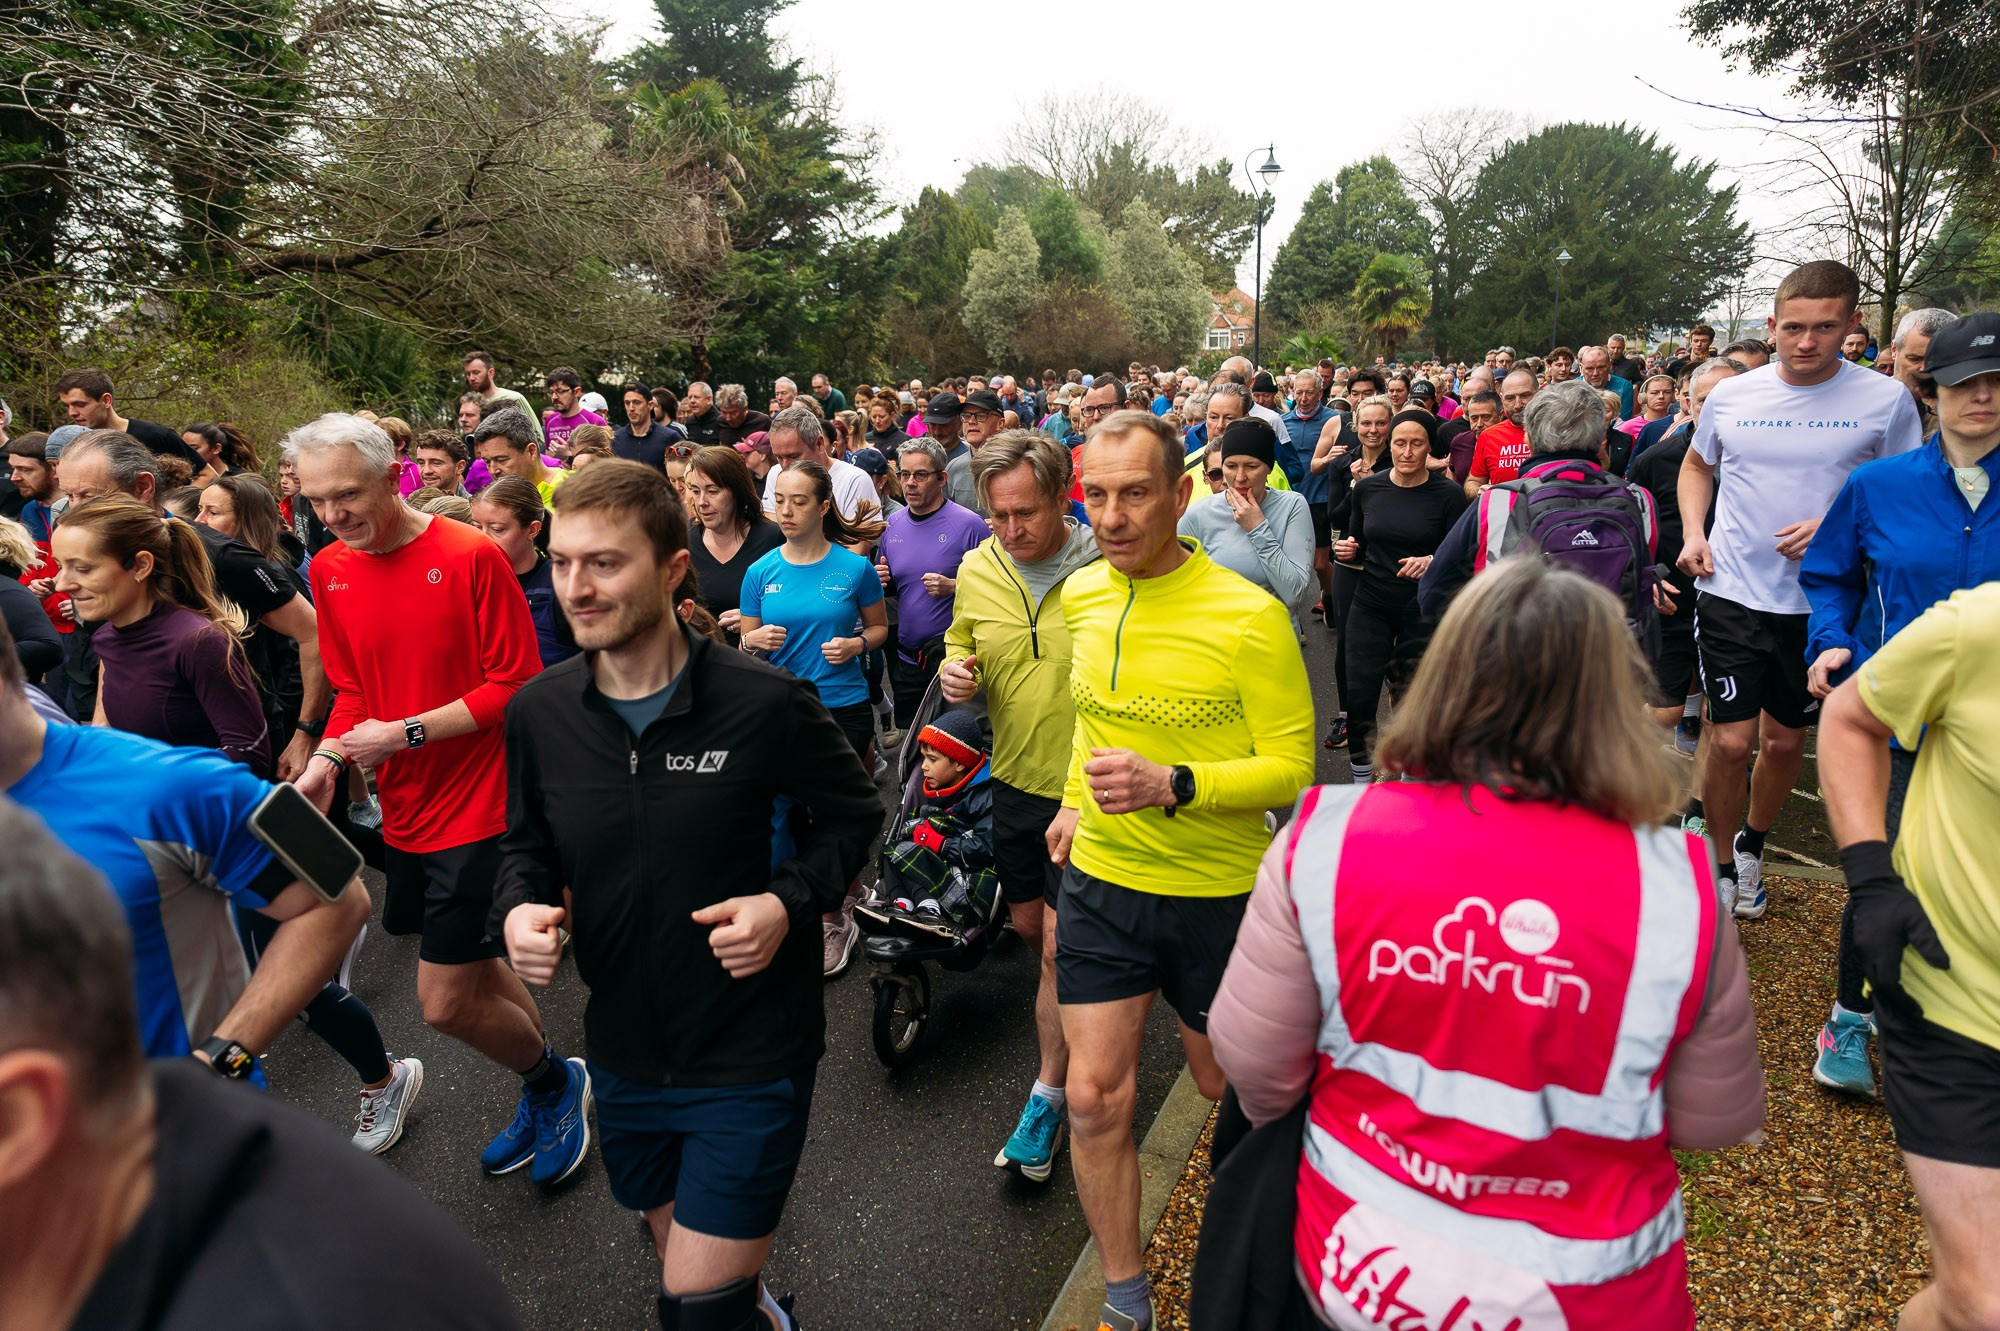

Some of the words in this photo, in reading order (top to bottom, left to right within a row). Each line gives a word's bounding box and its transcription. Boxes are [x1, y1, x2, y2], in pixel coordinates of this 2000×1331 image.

[1736, 420, 1792, 428] SKYPARK
[1808, 420, 1859, 429] CAIRNS
[1498, 458, 1525, 468] RUN
[764, 583, 783, 594] EMILY
[666, 752, 695, 771] tcs
[1367, 896, 1592, 1014] parkrun
